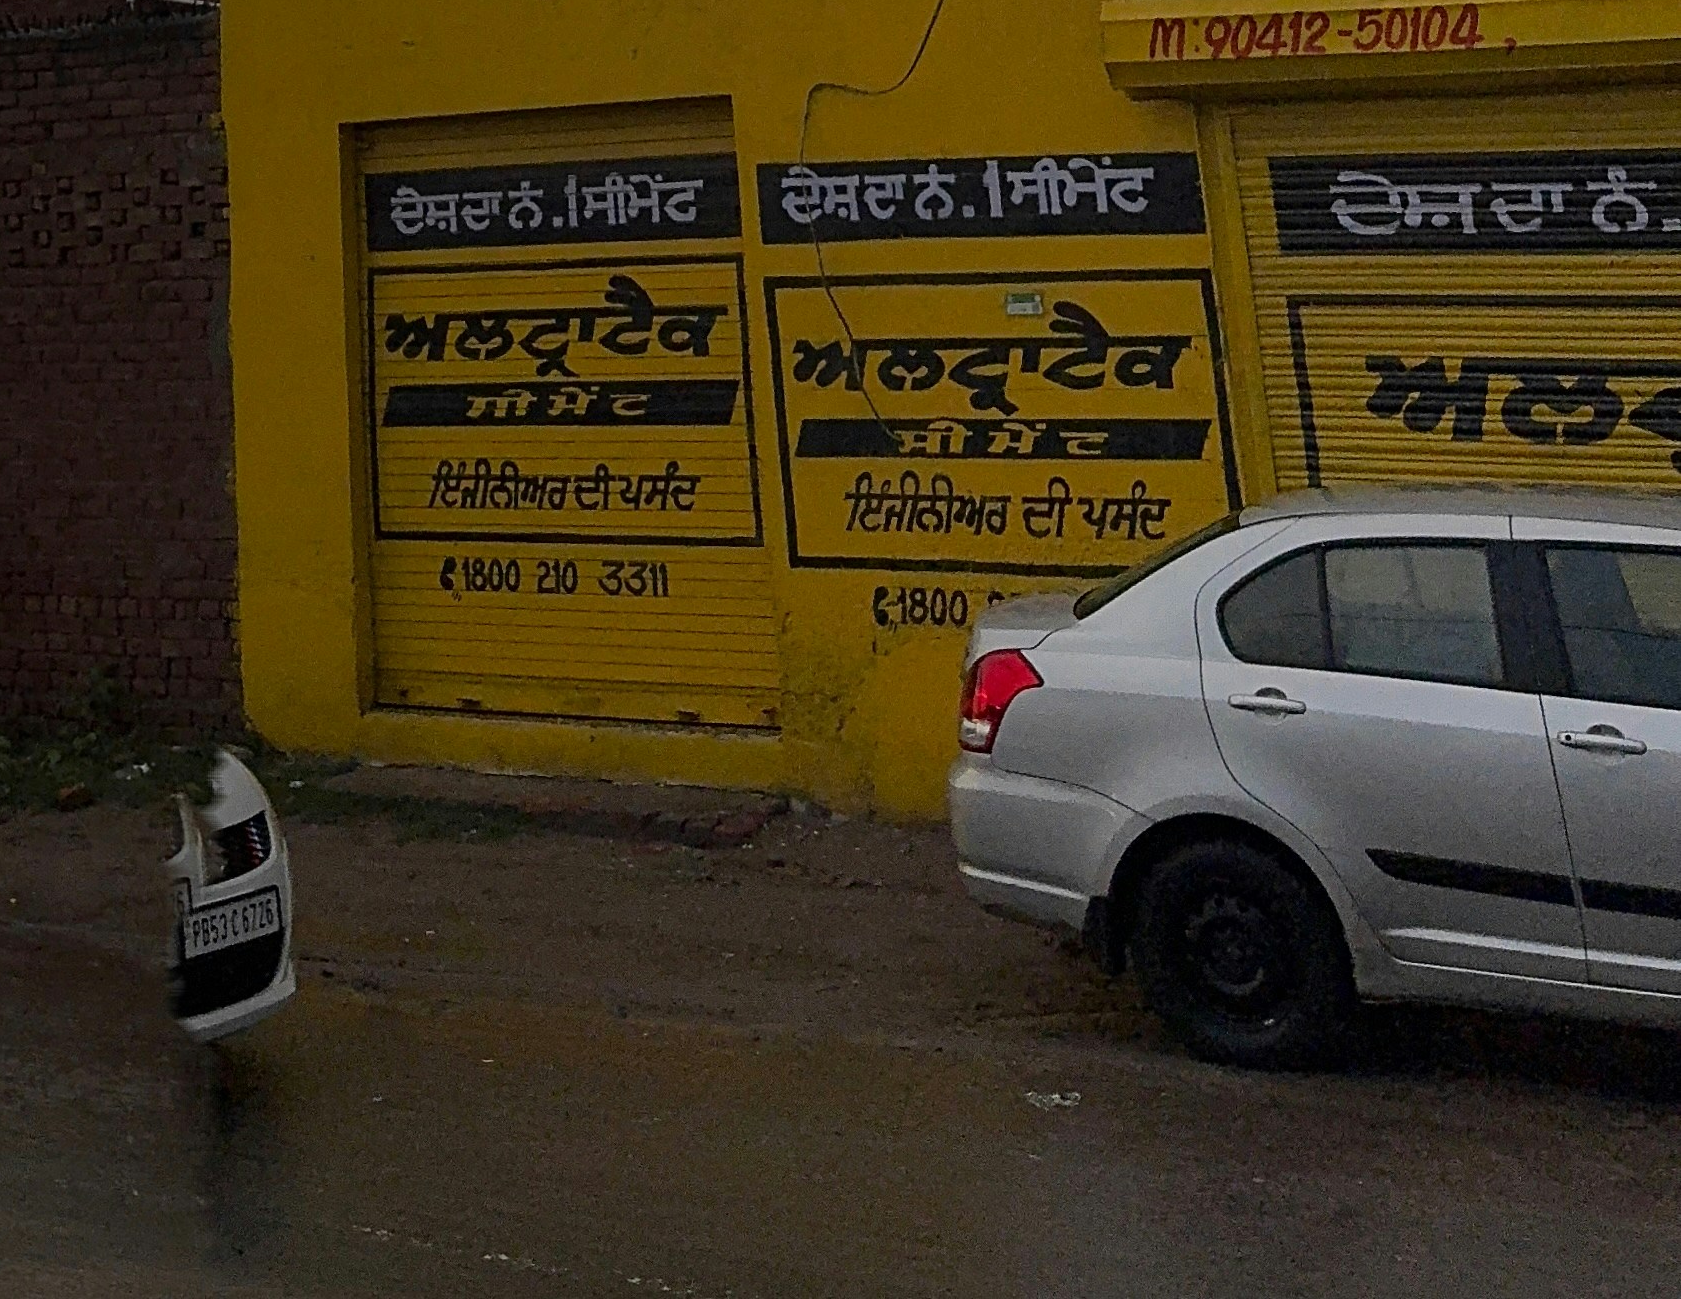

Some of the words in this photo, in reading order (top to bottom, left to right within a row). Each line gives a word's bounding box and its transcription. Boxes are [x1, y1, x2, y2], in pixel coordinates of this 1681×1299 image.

[461, 557, 521, 593] 1800
[537, 560, 579, 595] 210
[599, 560, 670, 597] 3311
